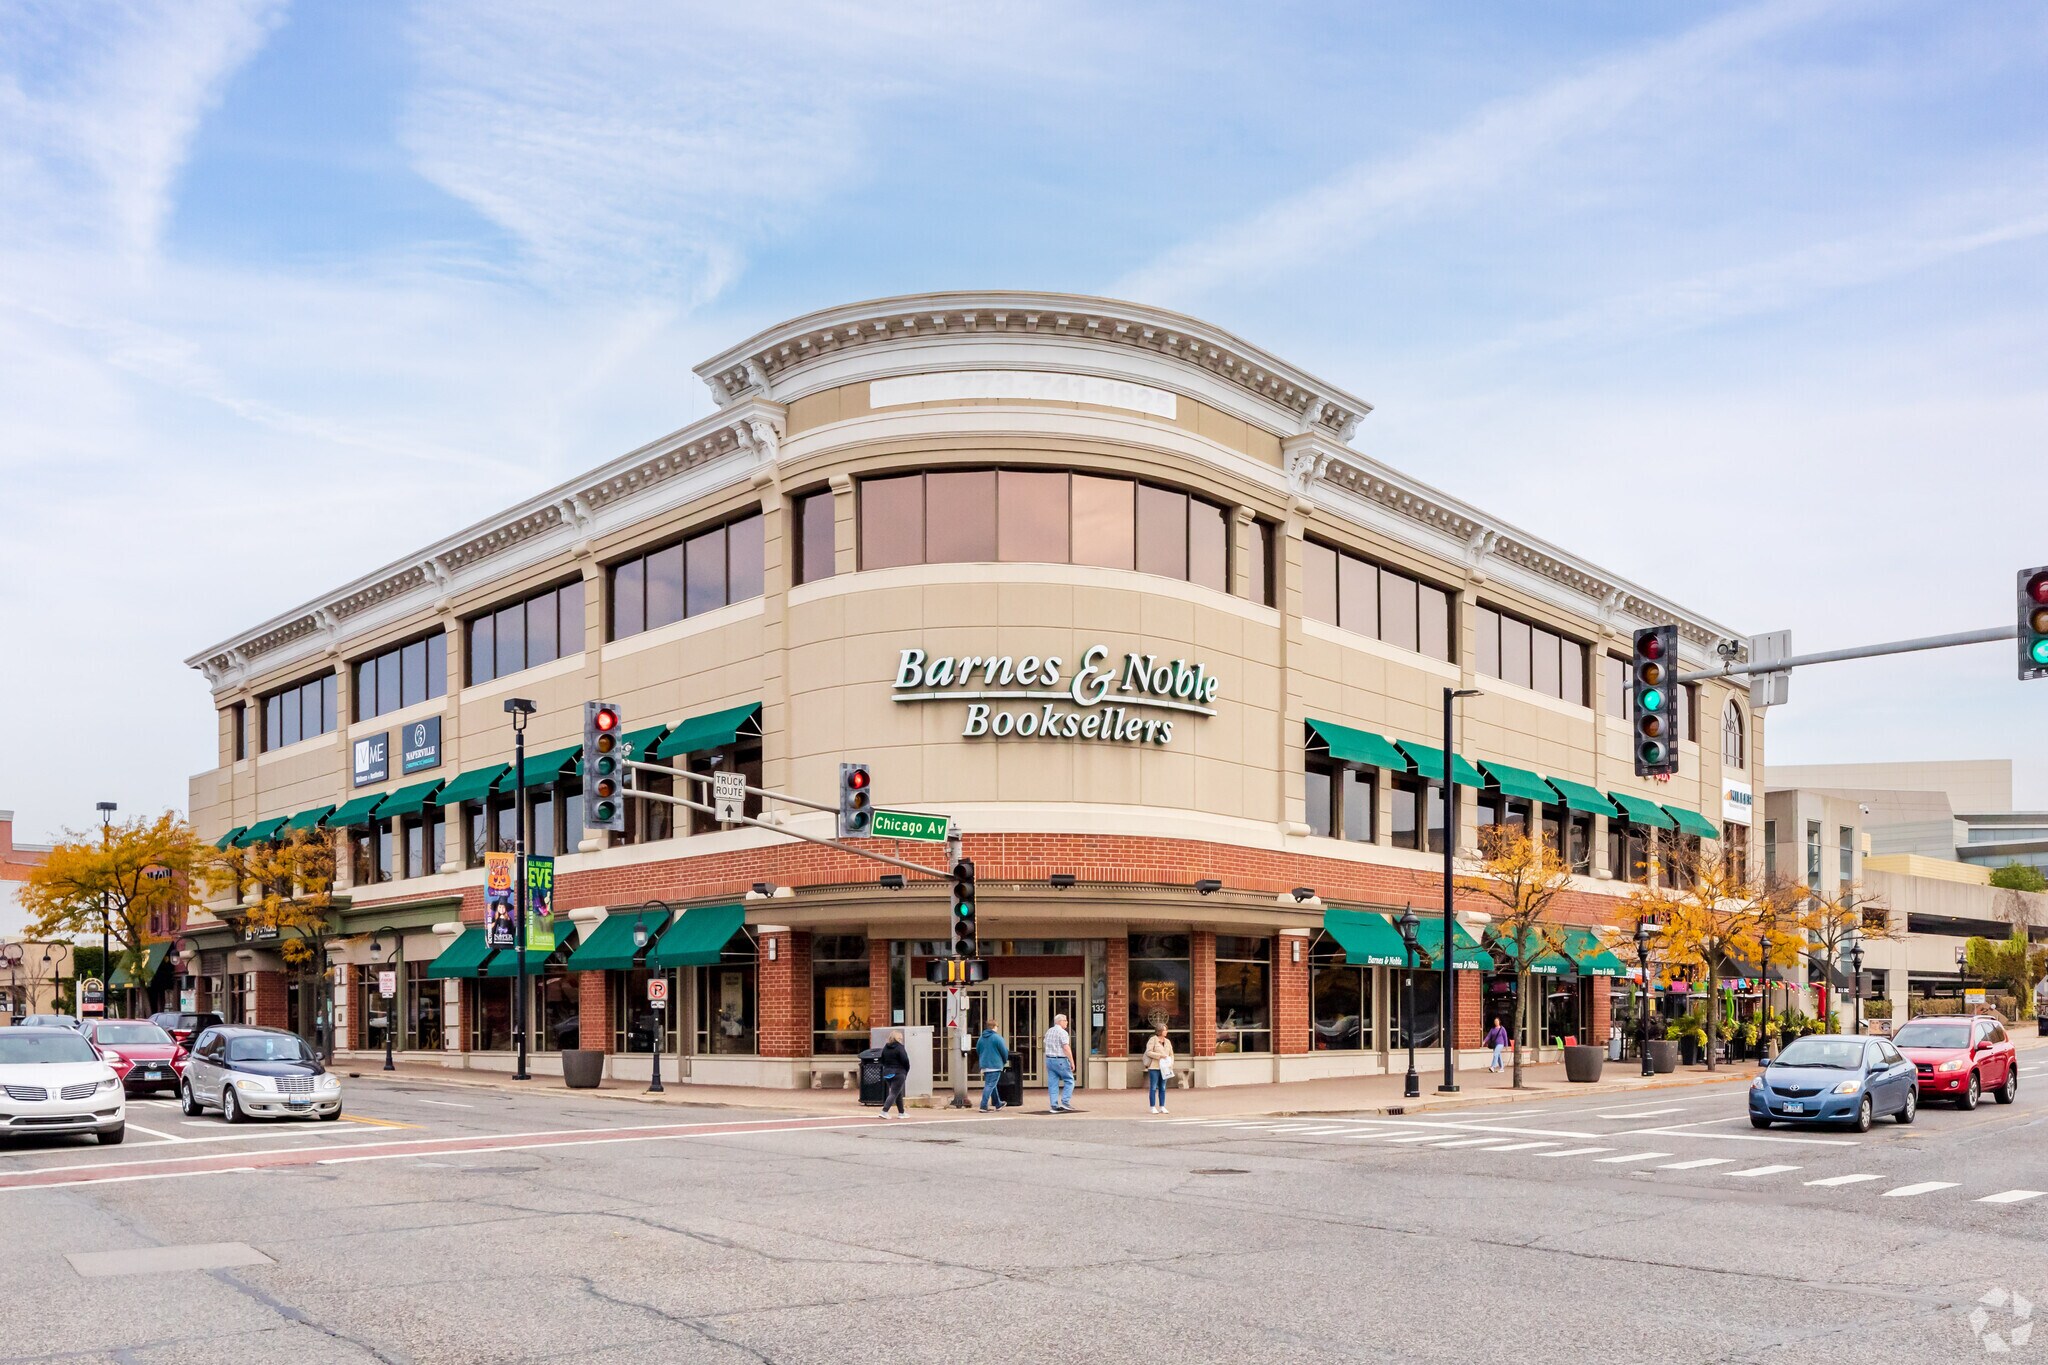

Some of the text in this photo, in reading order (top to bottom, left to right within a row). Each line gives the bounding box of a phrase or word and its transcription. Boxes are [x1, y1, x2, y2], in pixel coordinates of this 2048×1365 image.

[891, 644, 1219, 707] Barnes & Noble
[962, 703, 1175, 745] Booksellers
[405, 746, 435, 761] NAPERVILLE
[716, 775, 743, 787] TRUCK
[716, 786, 743, 797] ROUTE
[875, 816, 944, 836] Chicago Av
[528, 867, 552, 889] EVE
[1367, 956, 1402, 965] Barnes & Noble
[1531, 964, 1544, 973] Barnes
[1142, 987, 1175, 1002] Café
[1091, 1004, 1106, 1012] 132
